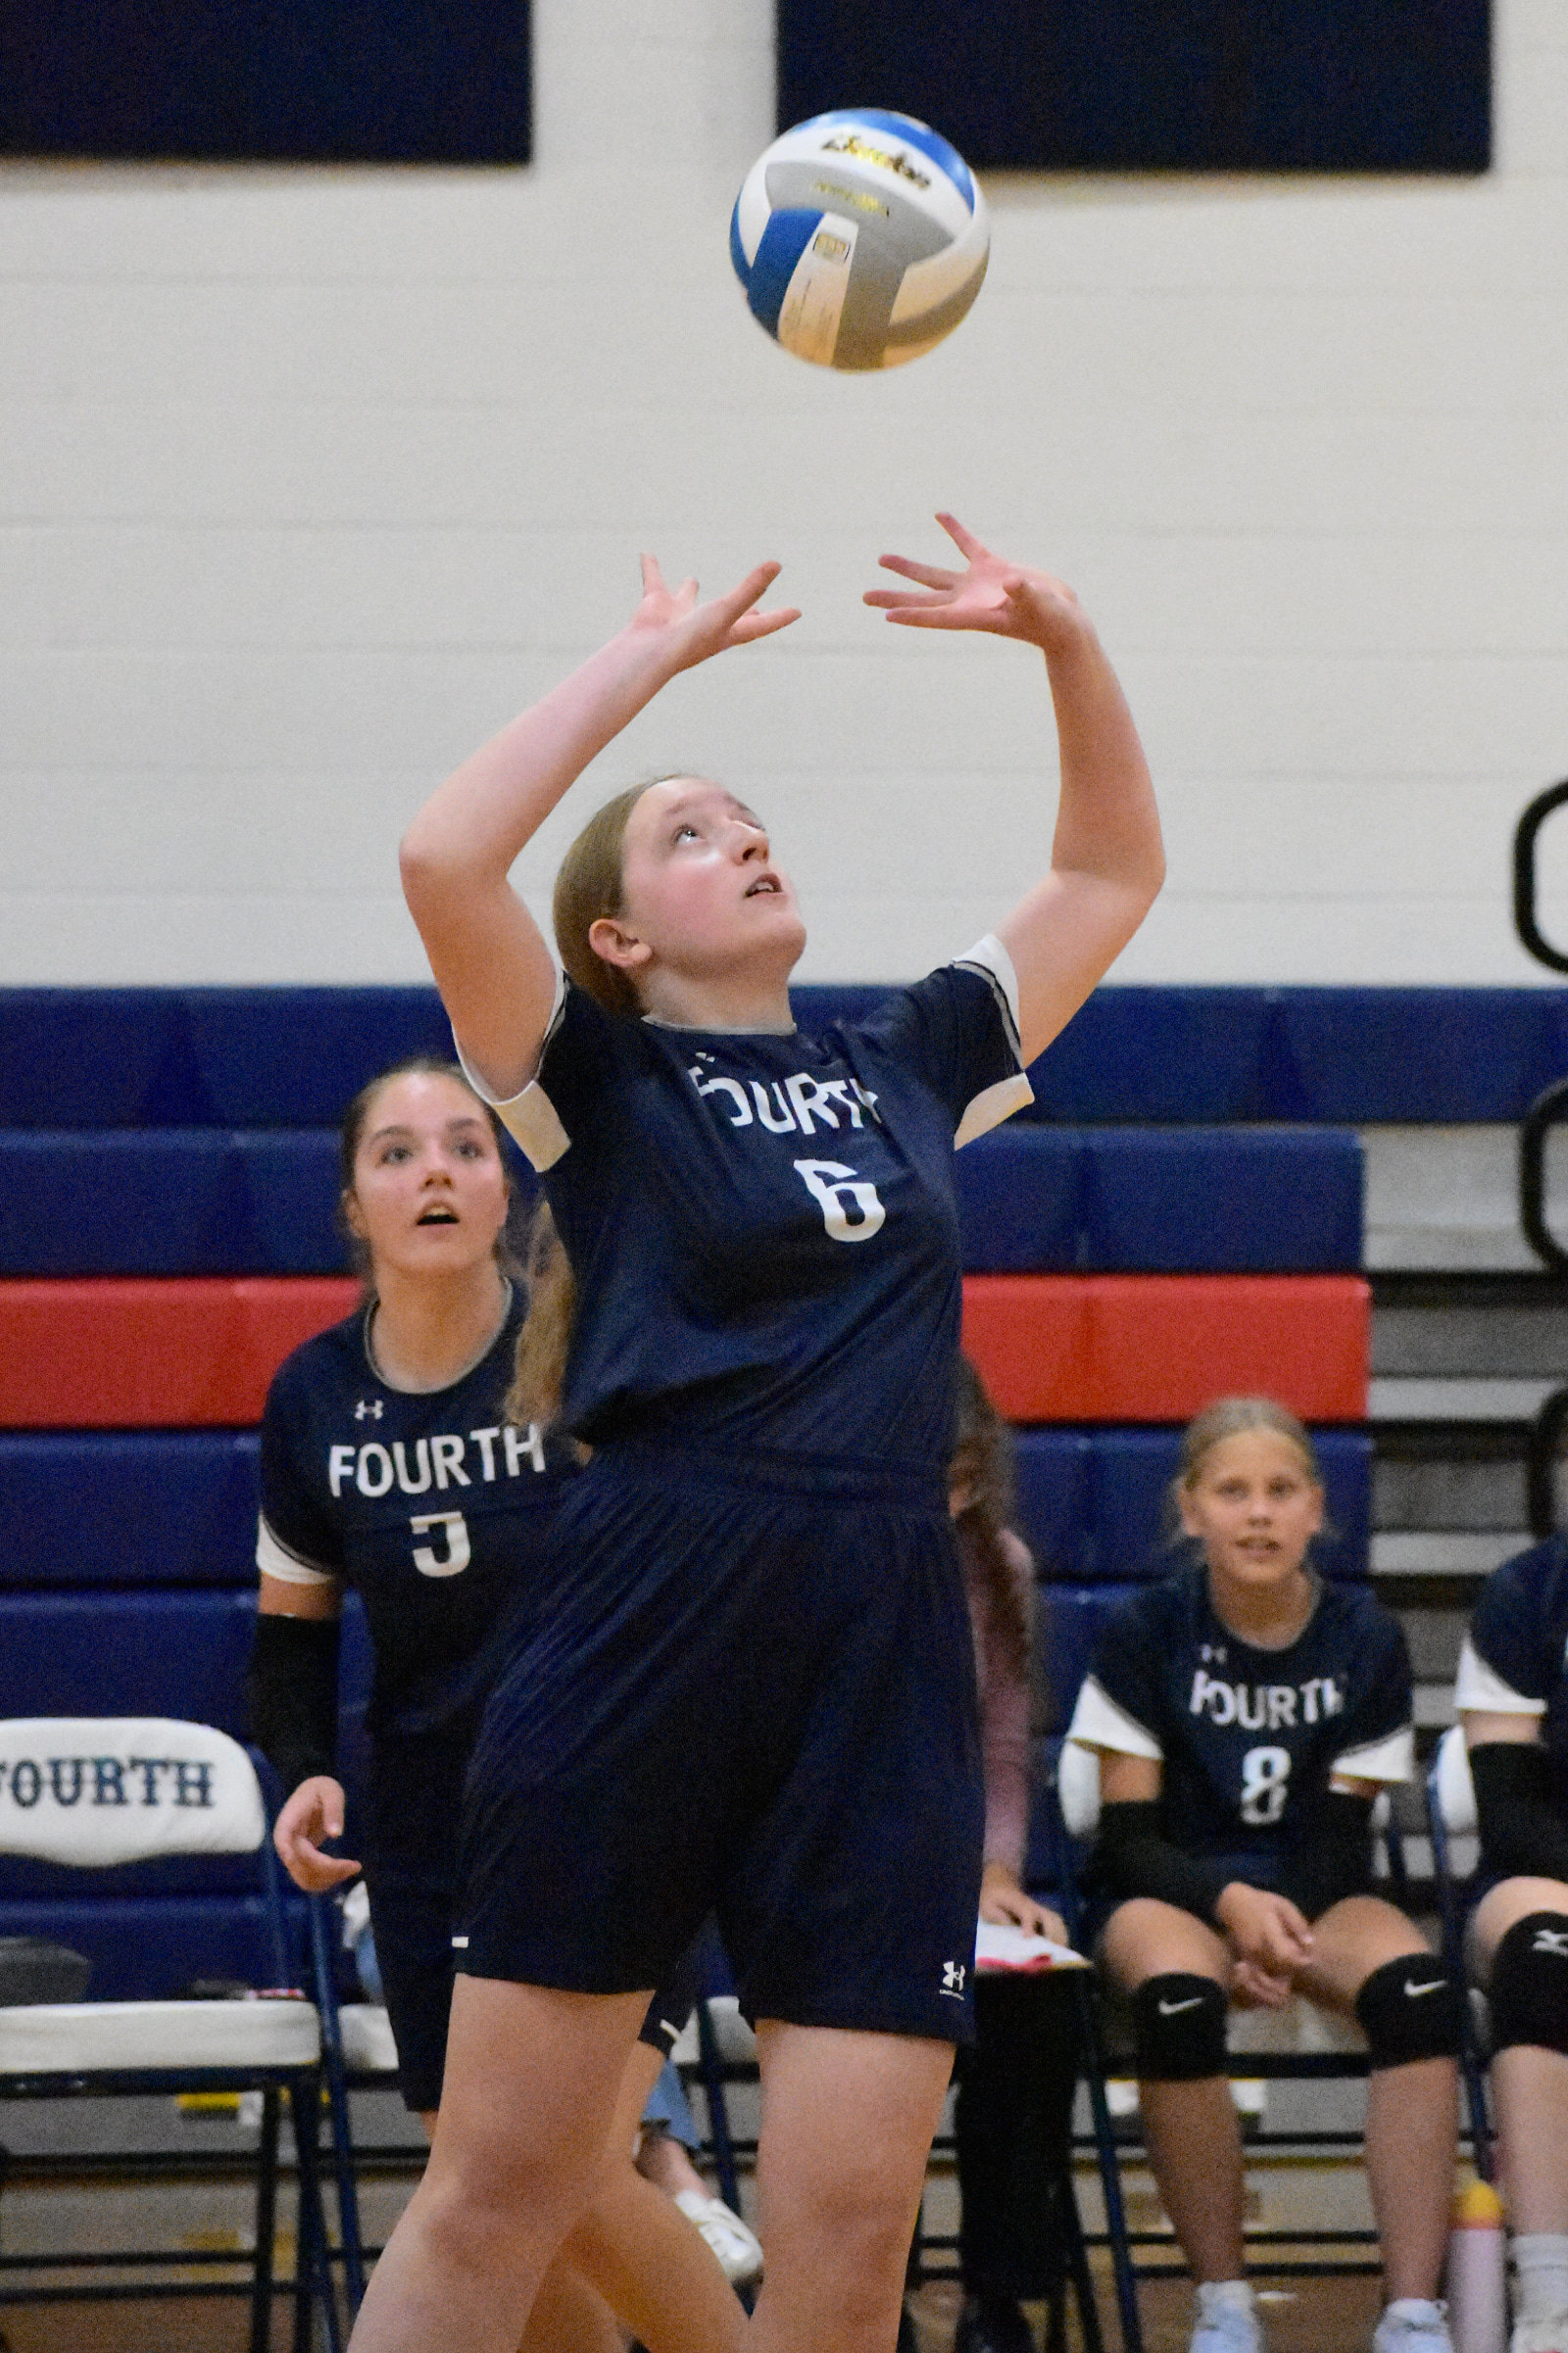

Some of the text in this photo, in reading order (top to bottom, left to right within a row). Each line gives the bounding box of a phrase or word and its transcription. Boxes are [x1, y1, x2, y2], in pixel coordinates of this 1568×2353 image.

[793, 1159, 885, 1242] 6
[328, 1425, 546, 1497] FOURTH
[1241, 1745, 1292, 1825] 8
